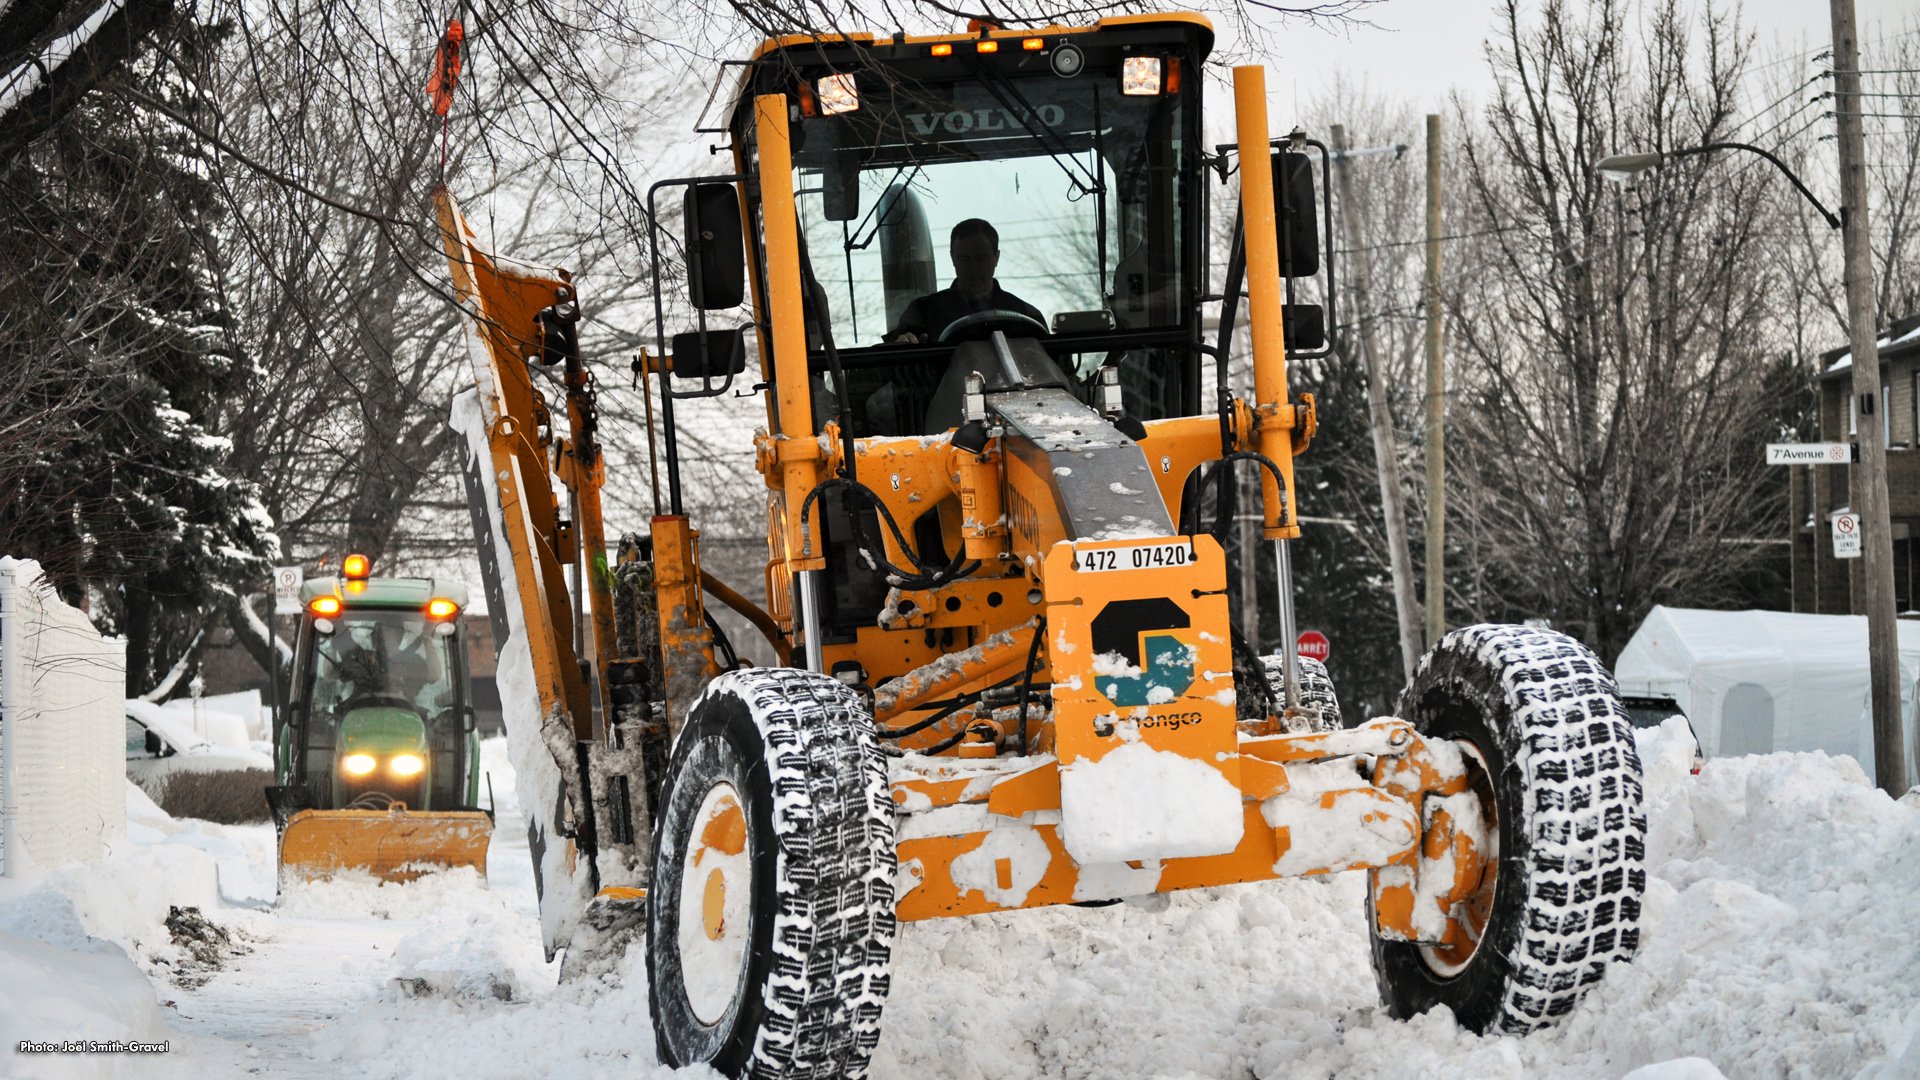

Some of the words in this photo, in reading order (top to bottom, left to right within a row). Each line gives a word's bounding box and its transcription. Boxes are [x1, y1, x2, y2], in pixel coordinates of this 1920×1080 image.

[904, 103, 1066, 136] VOLVO
[1783, 448, 1825, 459] Avenue
[1085, 550, 1117, 571] 472
[1132, 545, 1186, 568] 07420
